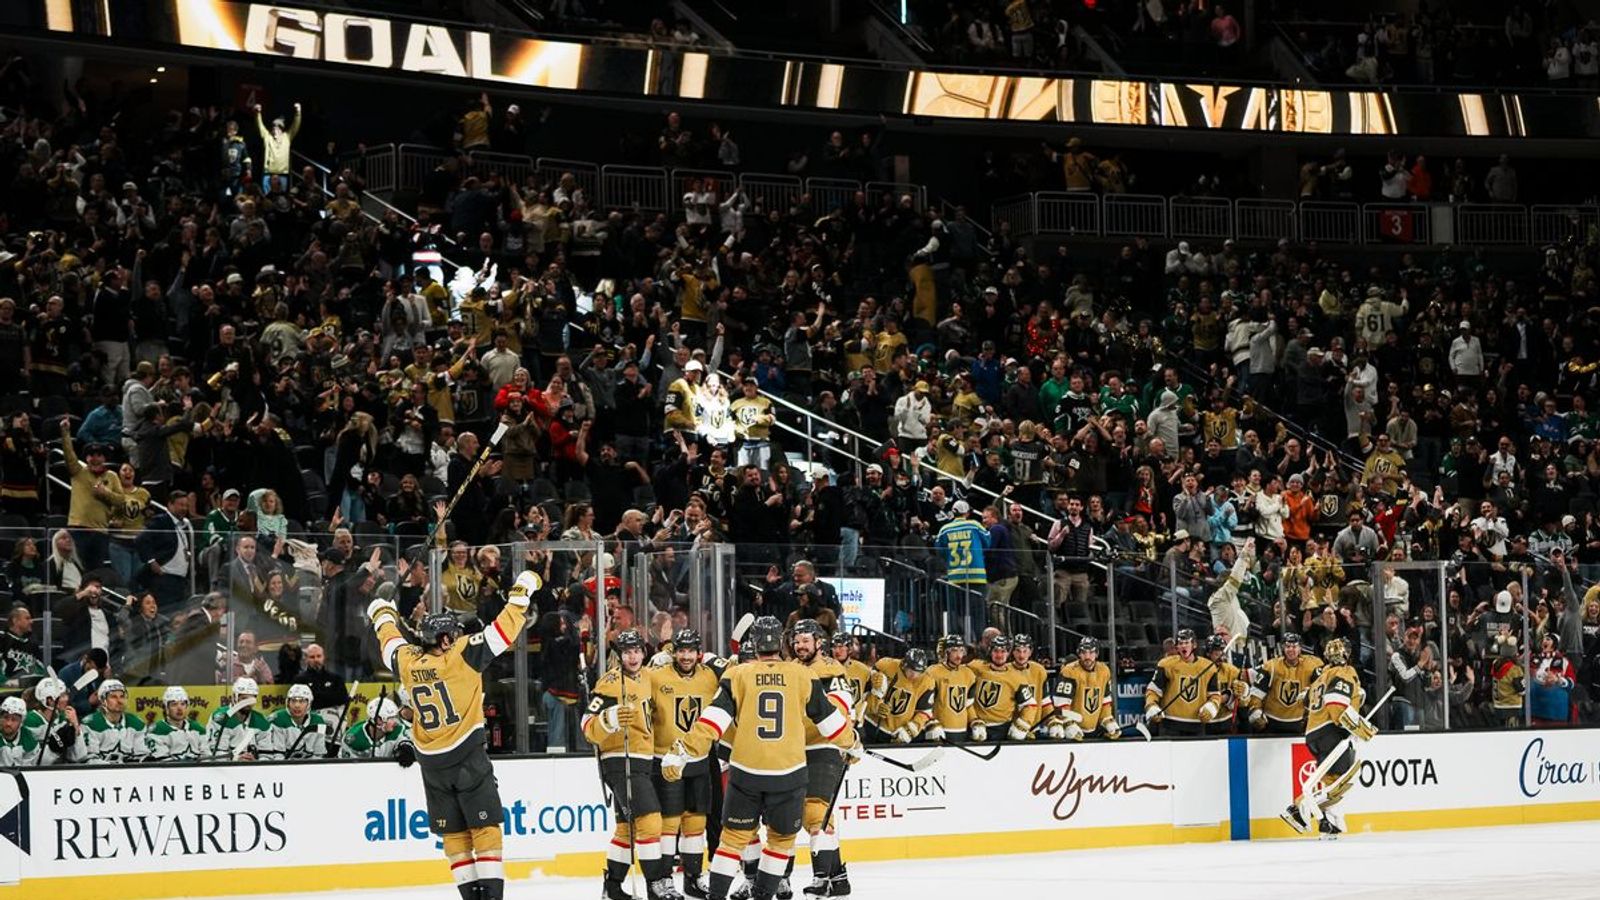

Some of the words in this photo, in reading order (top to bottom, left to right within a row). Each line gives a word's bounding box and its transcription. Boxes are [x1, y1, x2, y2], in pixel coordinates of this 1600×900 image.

[244, 3, 516, 82] GOAL
[1391, 215, 1402, 235] 3
[1367, 313, 1385, 331] 61
[948, 541, 973, 567] 33
[410, 668, 440, 682] STONE
[755, 673, 787, 687] EICHEL
[1056, 681, 1073, 695] 28
[411, 680, 461, 731] 61
[756, 690, 784, 741] 9
[1358, 758, 1439, 788] OYOTA
[1519, 737, 1588, 798] Circa
[53, 782, 285, 805] FONTAINEBLEAU
[844, 777, 872, 800] LE
[879, 775, 947, 798] BORN
[1031, 751, 1170, 821] Wynn
[838, 803, 904, 820] TEEL
[53, 810, 288, 861] REWARDS
